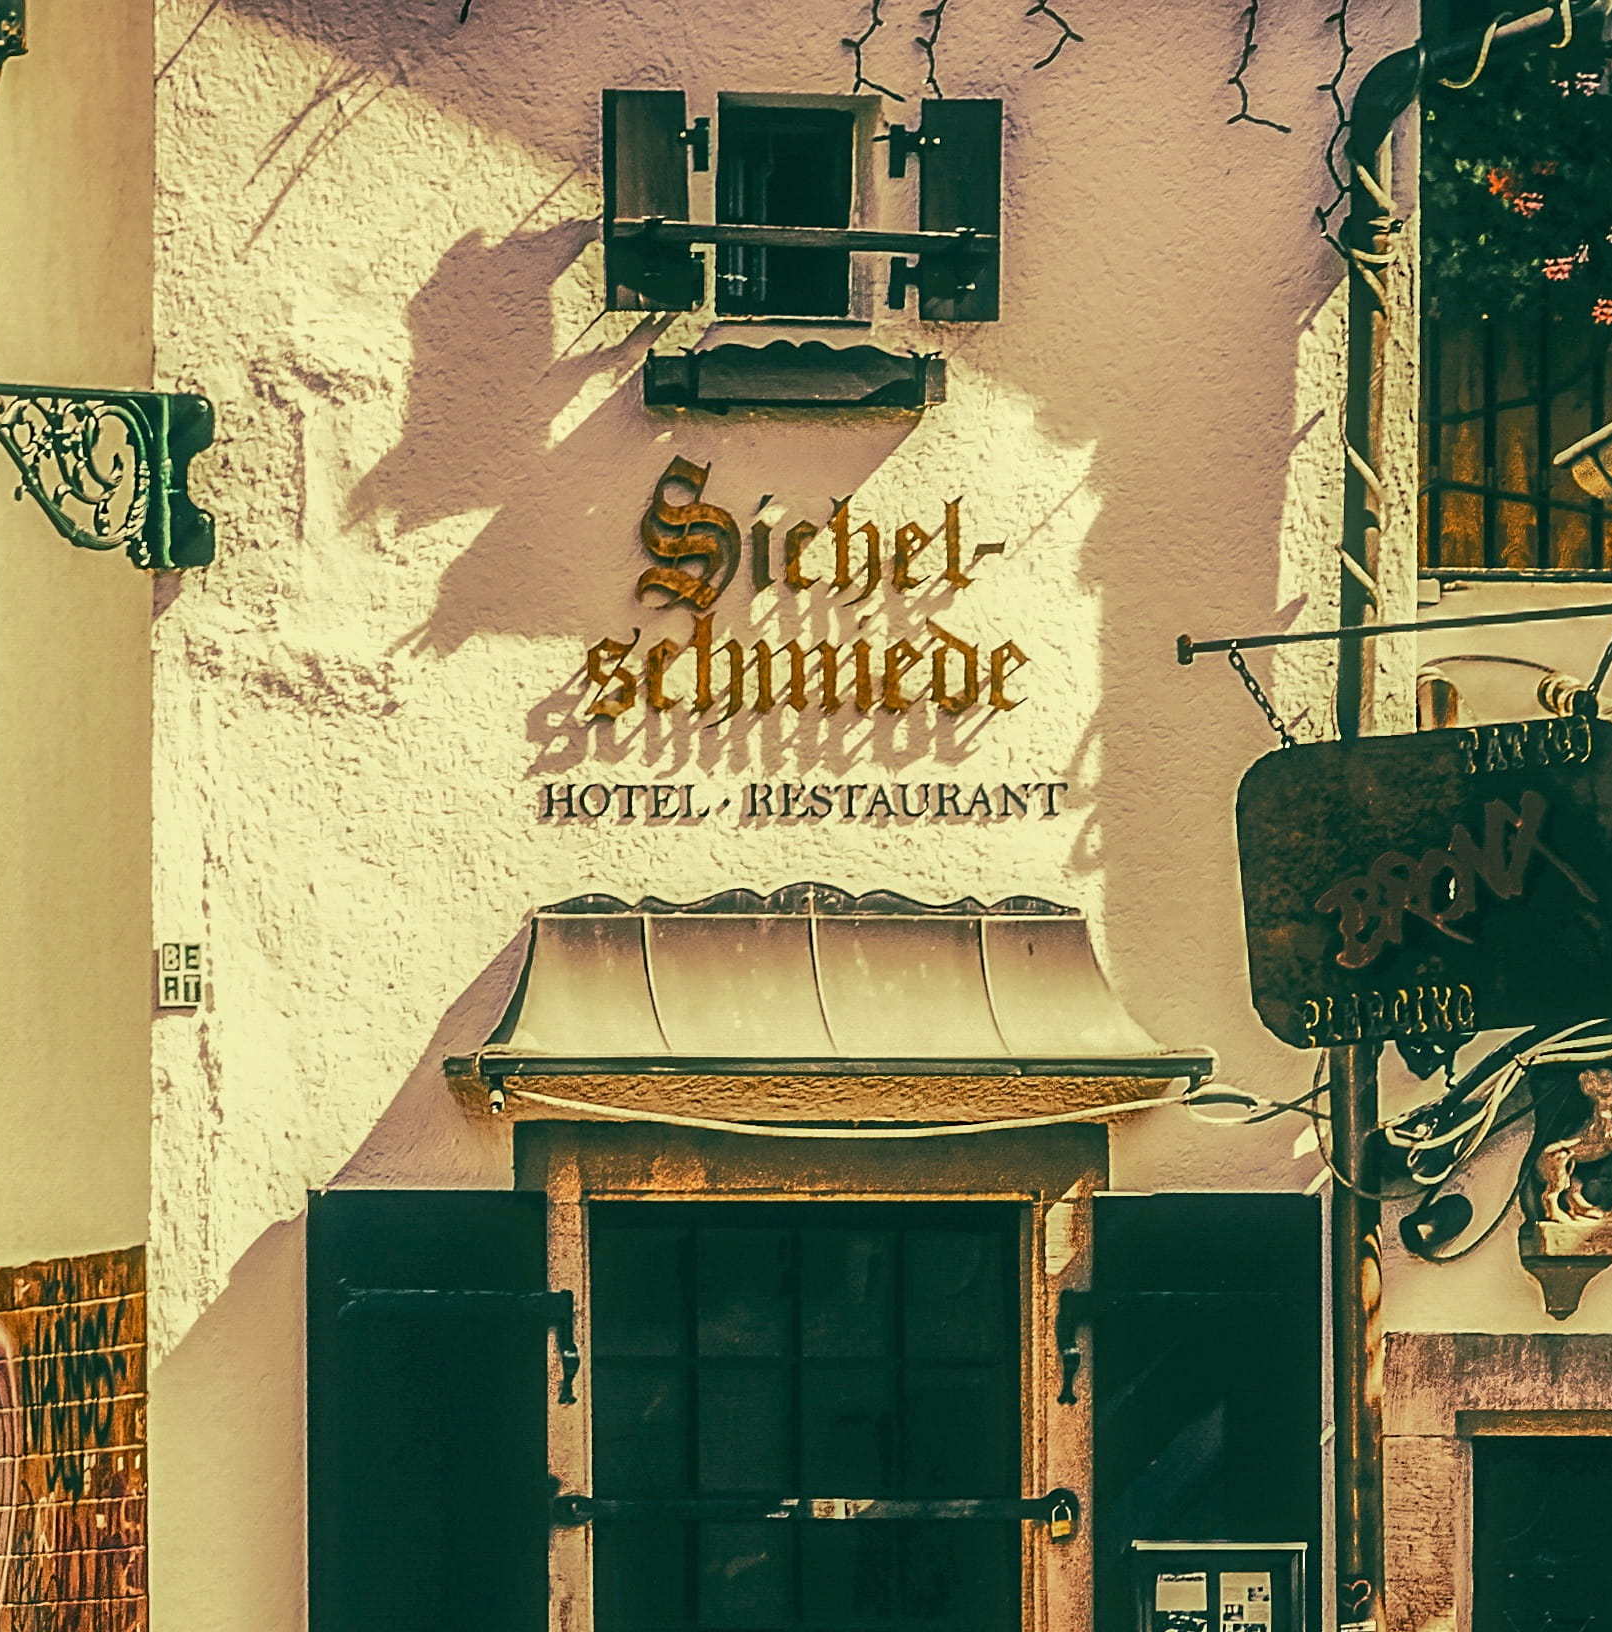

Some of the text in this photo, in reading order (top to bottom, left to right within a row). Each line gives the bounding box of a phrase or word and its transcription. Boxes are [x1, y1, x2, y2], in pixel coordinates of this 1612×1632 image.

[635, 454, 1007, 611] Sichel-
[585, 610, 1030, 730] schmiede
[540, 782, 1069, 818] HOTEL RESTAURANT
